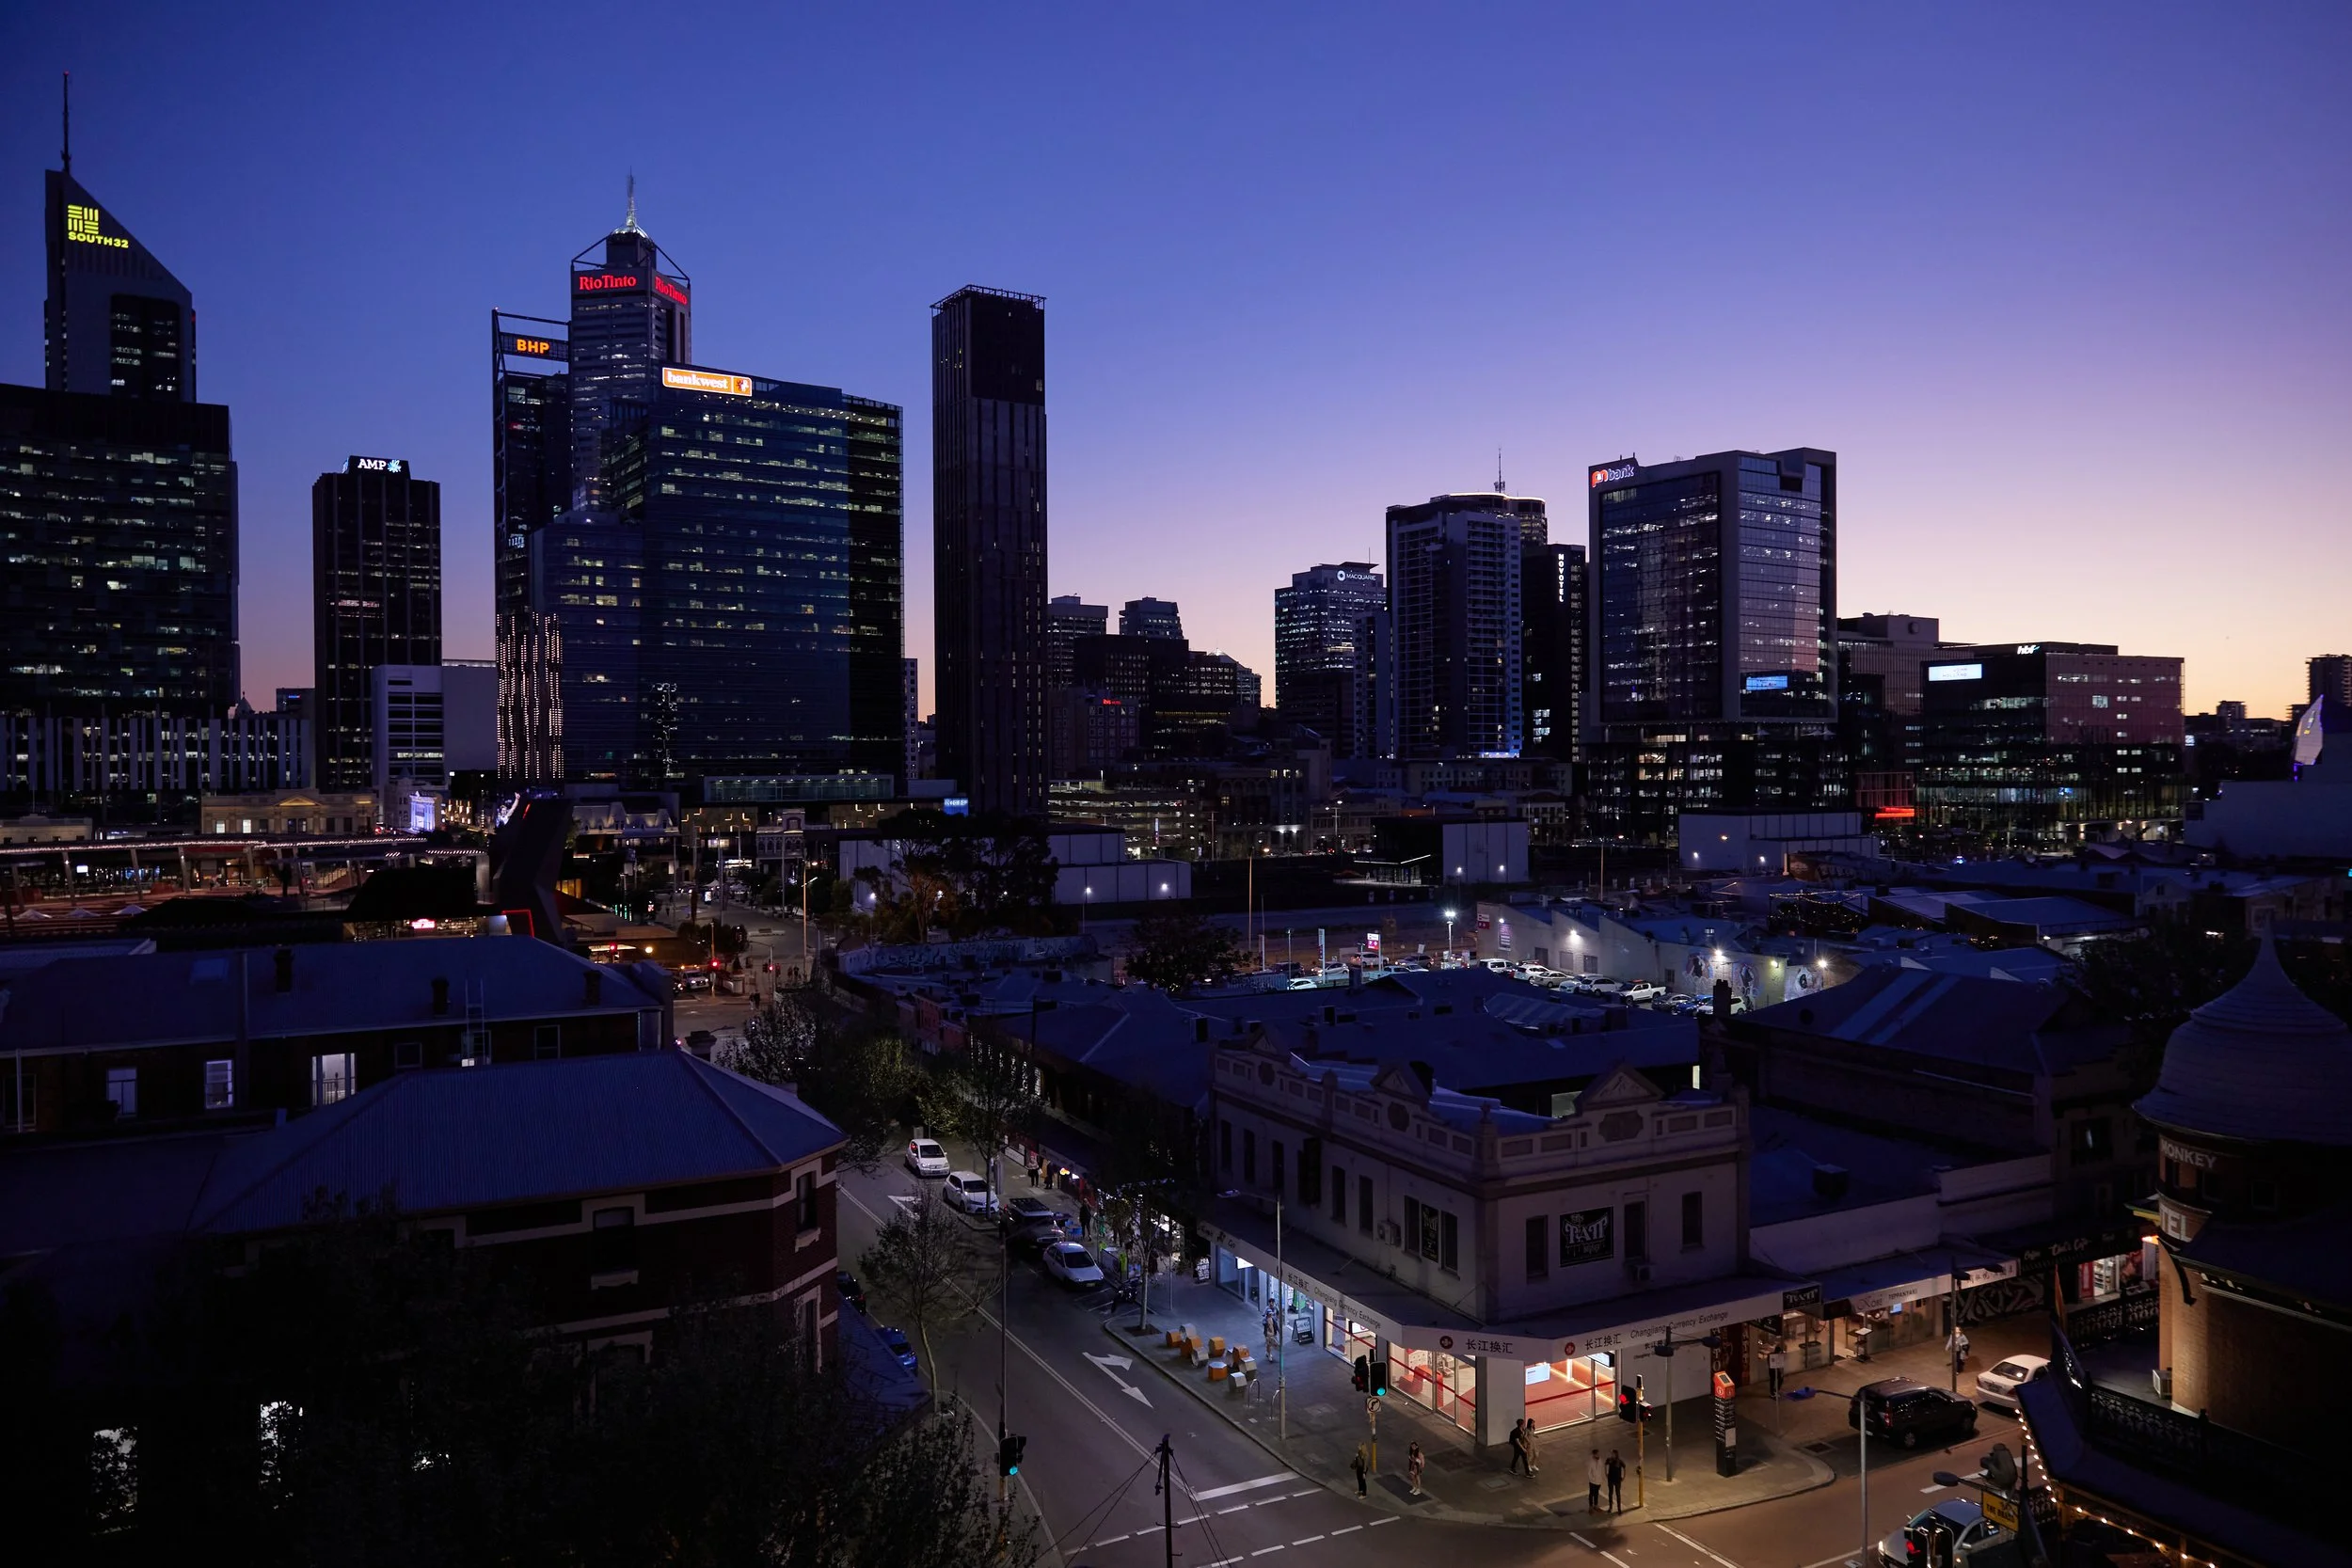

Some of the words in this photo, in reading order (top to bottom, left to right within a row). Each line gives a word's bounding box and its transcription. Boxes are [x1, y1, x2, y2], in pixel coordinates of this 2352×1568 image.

[68, 230, 129, 248] SOUTH32
[516, 339, 550, 355] BHP
[667, 371, 728, 389] bankwest
[358, 458, 387, 470] AMP
[2159, 1137, 2217, 1169] MONKEY
[1287, 1272, 1310, 1291] 长江换汇
[1584, 1333, 1622, 1351] 长江换汇
[1630, 1324, 1666, 1340] Changjiang
[1669, 1318, 1696, 1332] Currency
[1698, 1311, 1729, 1324] Exchange
[1465, 1338, 1513, 1354] 长江换汇
